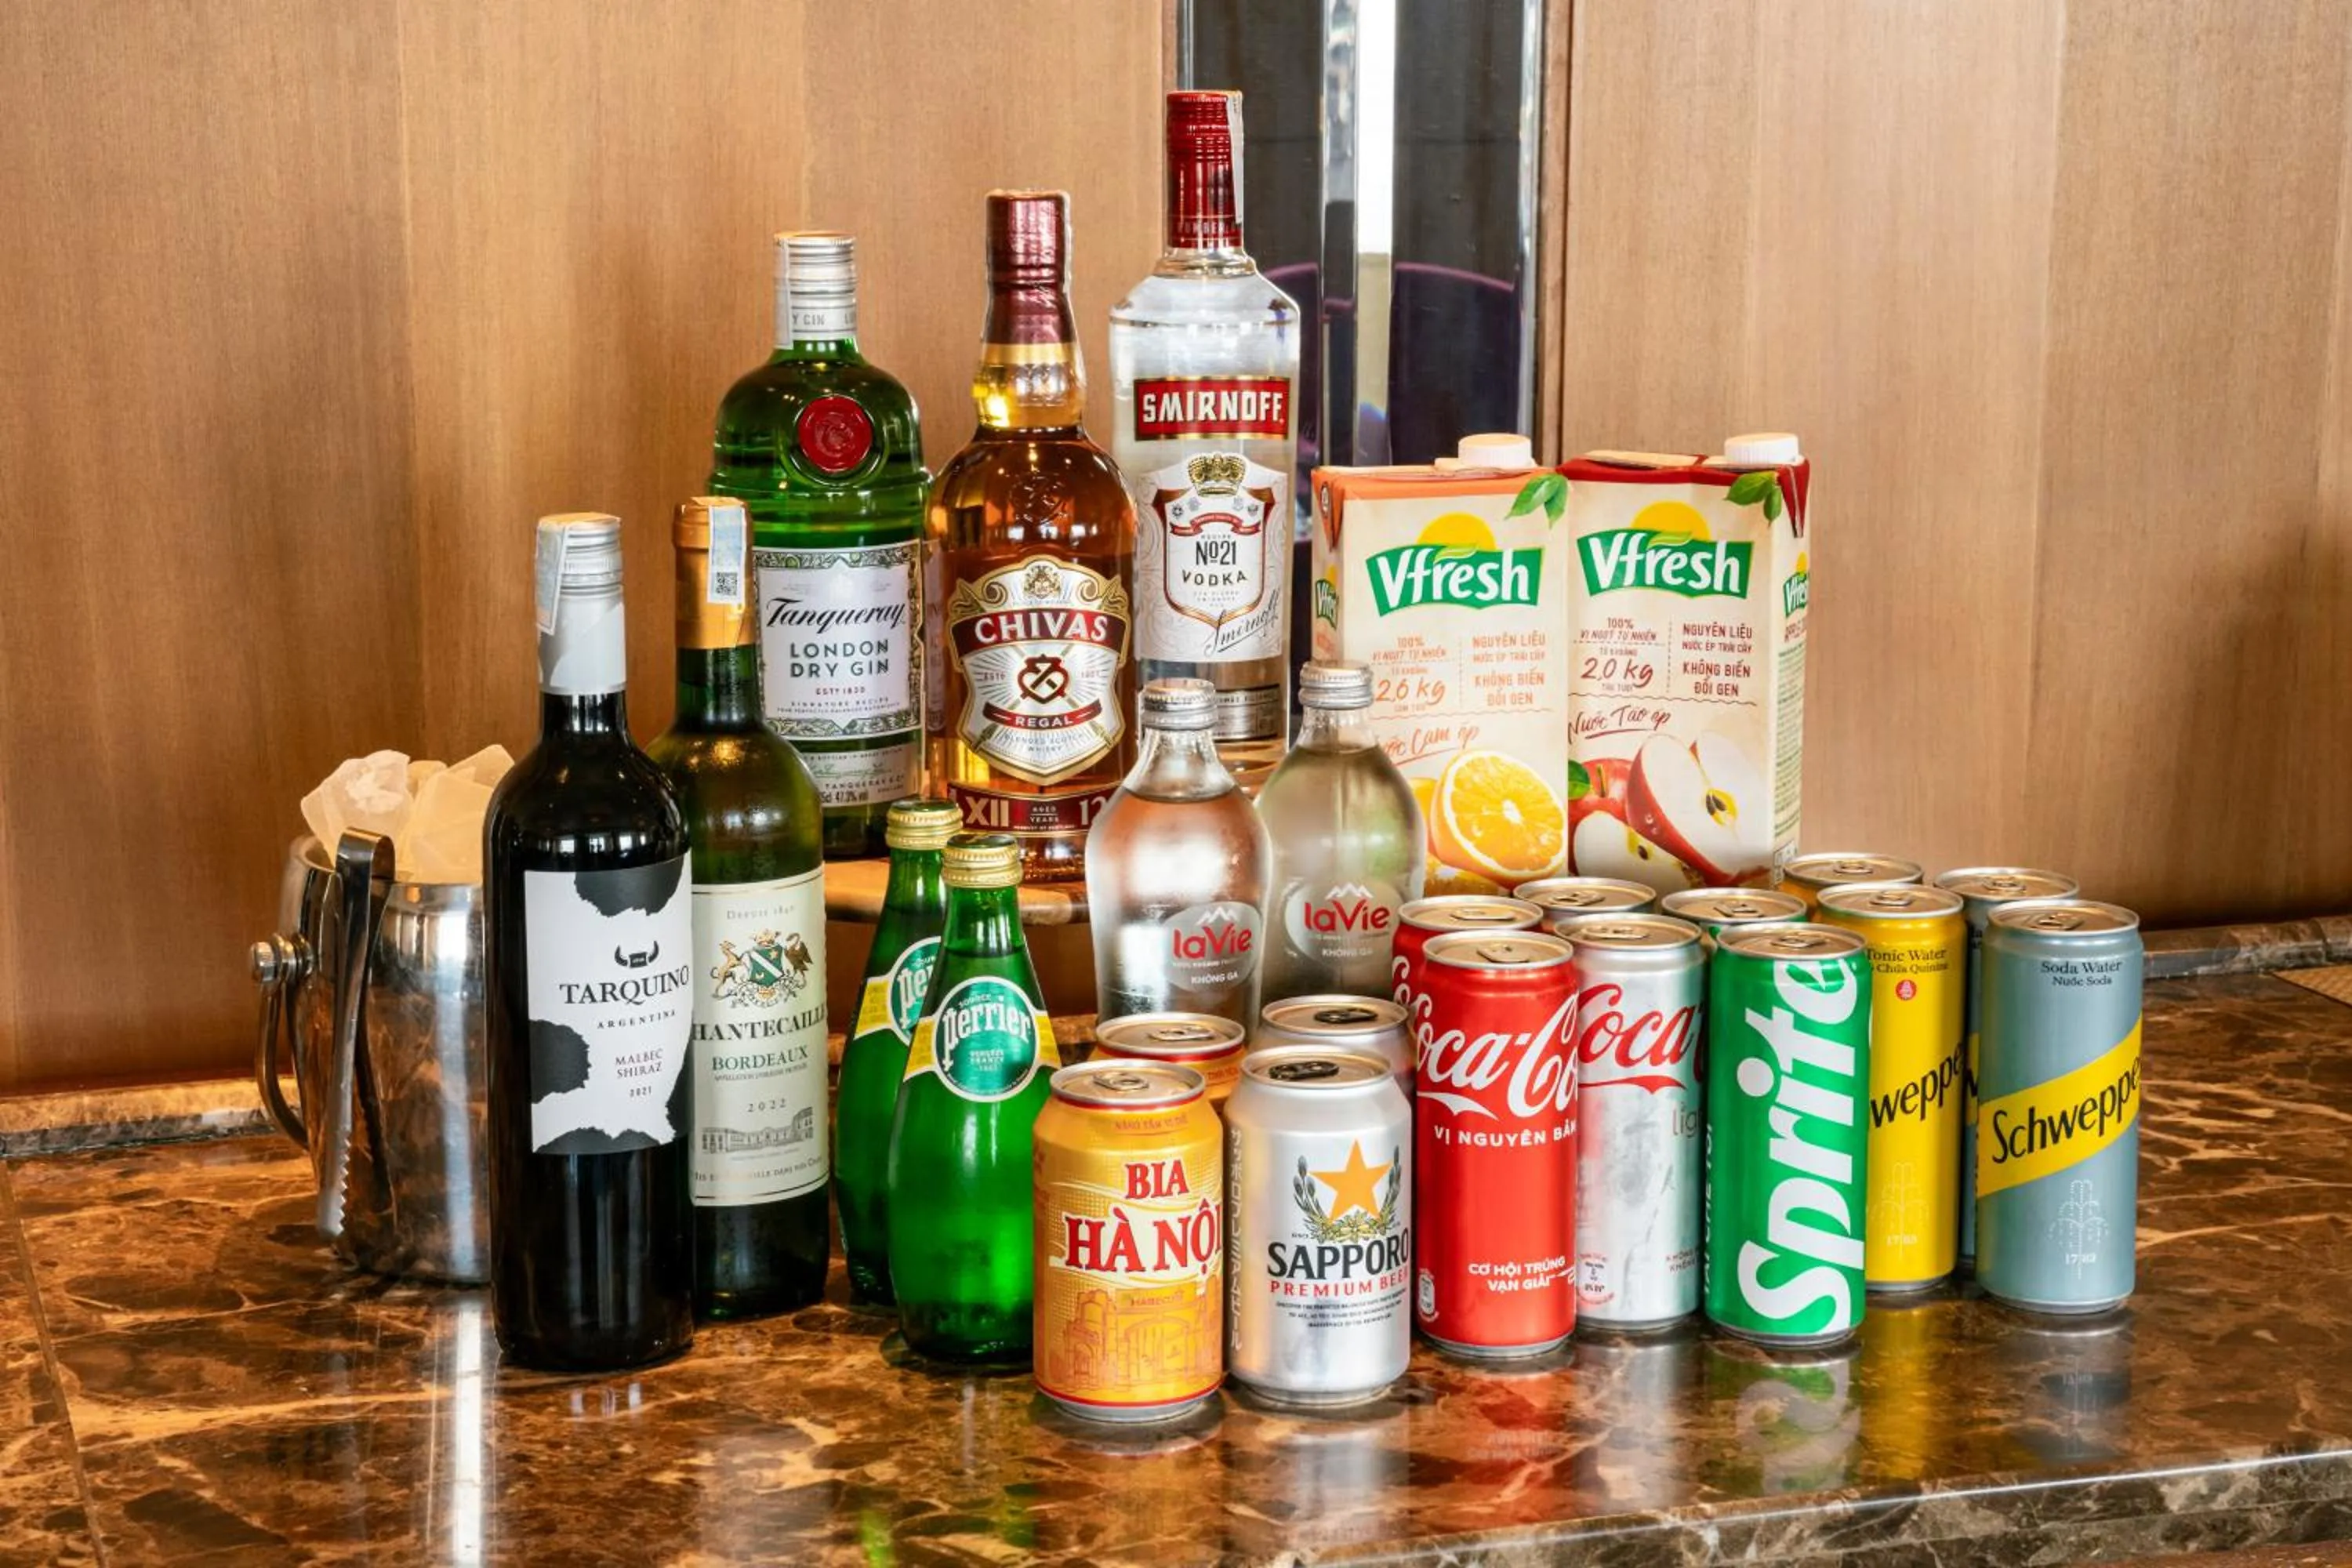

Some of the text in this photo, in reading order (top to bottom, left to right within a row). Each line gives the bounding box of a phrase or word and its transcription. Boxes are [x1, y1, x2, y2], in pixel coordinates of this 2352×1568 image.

[1142, 390, 1283, 423] SMIRNOFF
[1588, 532, 1741, 593] Vfresh
[1181, 570, 1248, 586] VODKA
[1377, 547, 1530, 609] Vfresh
[766, 597, 906, 634] Tanqueray
[1606, 617, 1634, 629] 100%
[975, 611, 1108, 644] CHIVAS
[789, 640, 889, 659] LONDON
[789, 659, 889, 679] DRY GIN
[1623, 657, 1653, 688] kg
[1683, 659, 1721, 676] KHÔNG
[1416, 675, 1446, 706] kg
[1716, 683, 1739, 696] GEN
[1014, 717, 1074, 728] REGAL
[965, 796, 1010, 827] XII
[1303, 898, 1390, 932] laVie
[1173, 923, 1253, 960] laVie
[1867, 948, 1947, 961] Tonic Water
[2041, 960, 2123, 975] Soda Water
[559, 965, 690, 1006] TARQUINO
[2086, 975, 2113, 985] Soda
[597, 1010, 677, 1029] ARGENTINA
[615, 1048, 663, 1065] MALBEC
[712, 1044, 808, 1071] BORDEAUX
[616, 1062, 662, 1079] SHIRAZ
[747, 1098, 786, 1112] 2022
[1458, 1129, 1546, 1147] NGUYÊN
[1737, 960, 1864, 1333] Sprite
[1124, 1159, 1189, 1200] BIA
[1065, 1198, 1221, 1275] HÀ NỘI
[1267, 1227, 1409, 1279] SAPPORO
[1494, 1261, 1521, 1278] HỘI
[1525, 1256, 1566, 1274] TRÚNG
[1270, 1281, 1373, 1298] PREMIUM
[1487, 1279, 1519, 1294] VẠN
